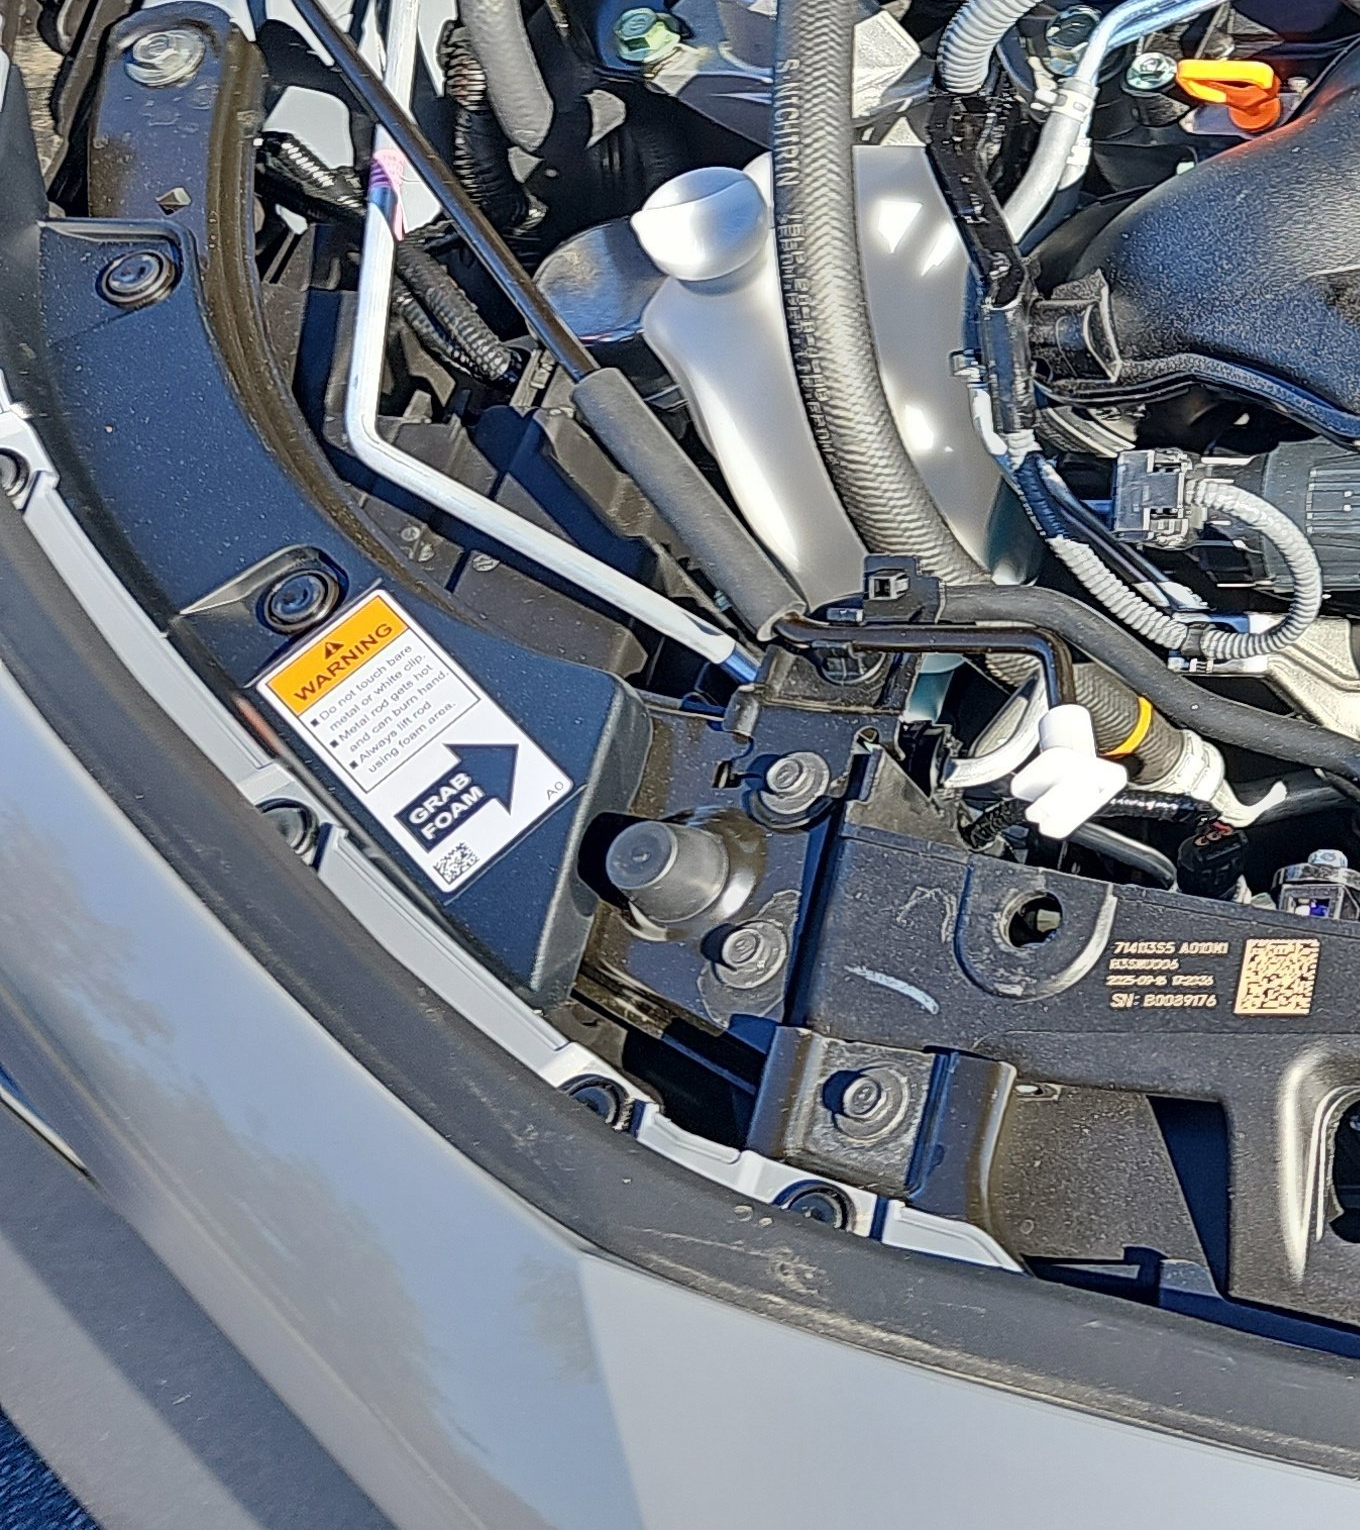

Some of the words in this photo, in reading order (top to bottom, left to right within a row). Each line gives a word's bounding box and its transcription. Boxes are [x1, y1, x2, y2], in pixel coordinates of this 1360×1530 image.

[294, 622, 394, 702] WARNING
[319, 706, 336, 720] Do
[338, 689, 356, 706] not
[356, 666, 387, 691] touch
[386, 645, 412, 667] bare
[329, 704, 360, 731] metal
[361, 695, 372, 706] or
[374, 672, 402, 695] white
[404, 654, 426, 671] clip.
[338, 715, 370, 742] Metal
[371, 699, 389, 717] rod
[390, 680, 414, 701] gets
[414, 664, 433, 681] hot
[349, 732, 371, 752] and
[372, 716, 392, 734] can
[392, 696, 418, 716] burn
[418, 671, 449, 696] hand.
[359, 731, 397, 763] Always
[396, 716, 412, 731] lift
[413, 701, 431, 719] rod
[368, 747, 399, 772] using
[398, 724, 426, 748] foam
[428, 703, 456, 725] area.
[409, 772, 472, 824] GRAB
[420, 785, 486, 840] FOAM
